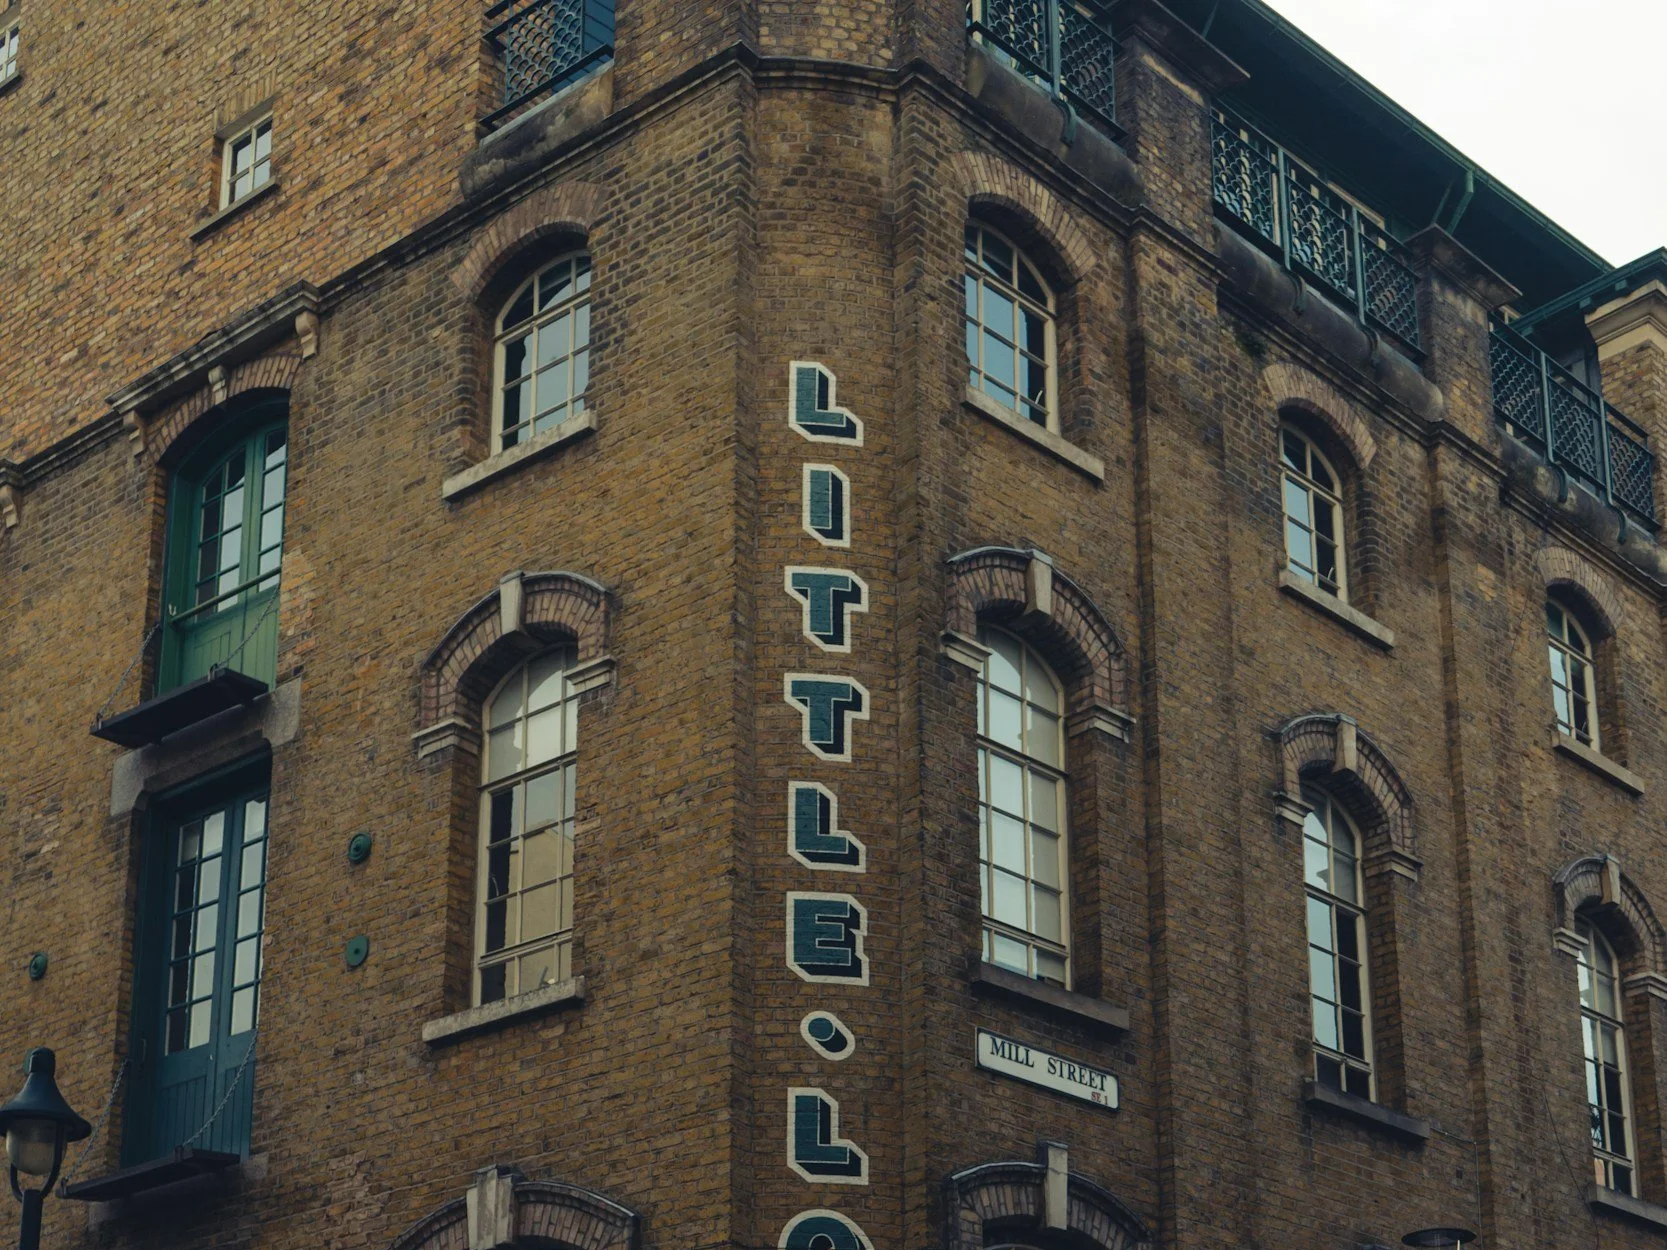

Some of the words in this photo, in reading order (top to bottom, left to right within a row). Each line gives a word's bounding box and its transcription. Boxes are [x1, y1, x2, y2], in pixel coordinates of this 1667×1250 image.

[784, 361, 870, 986] LITTLE
[990, 1036, 1034, 1068] MILL
[1047, 1057, 1107, 1091] STREET
